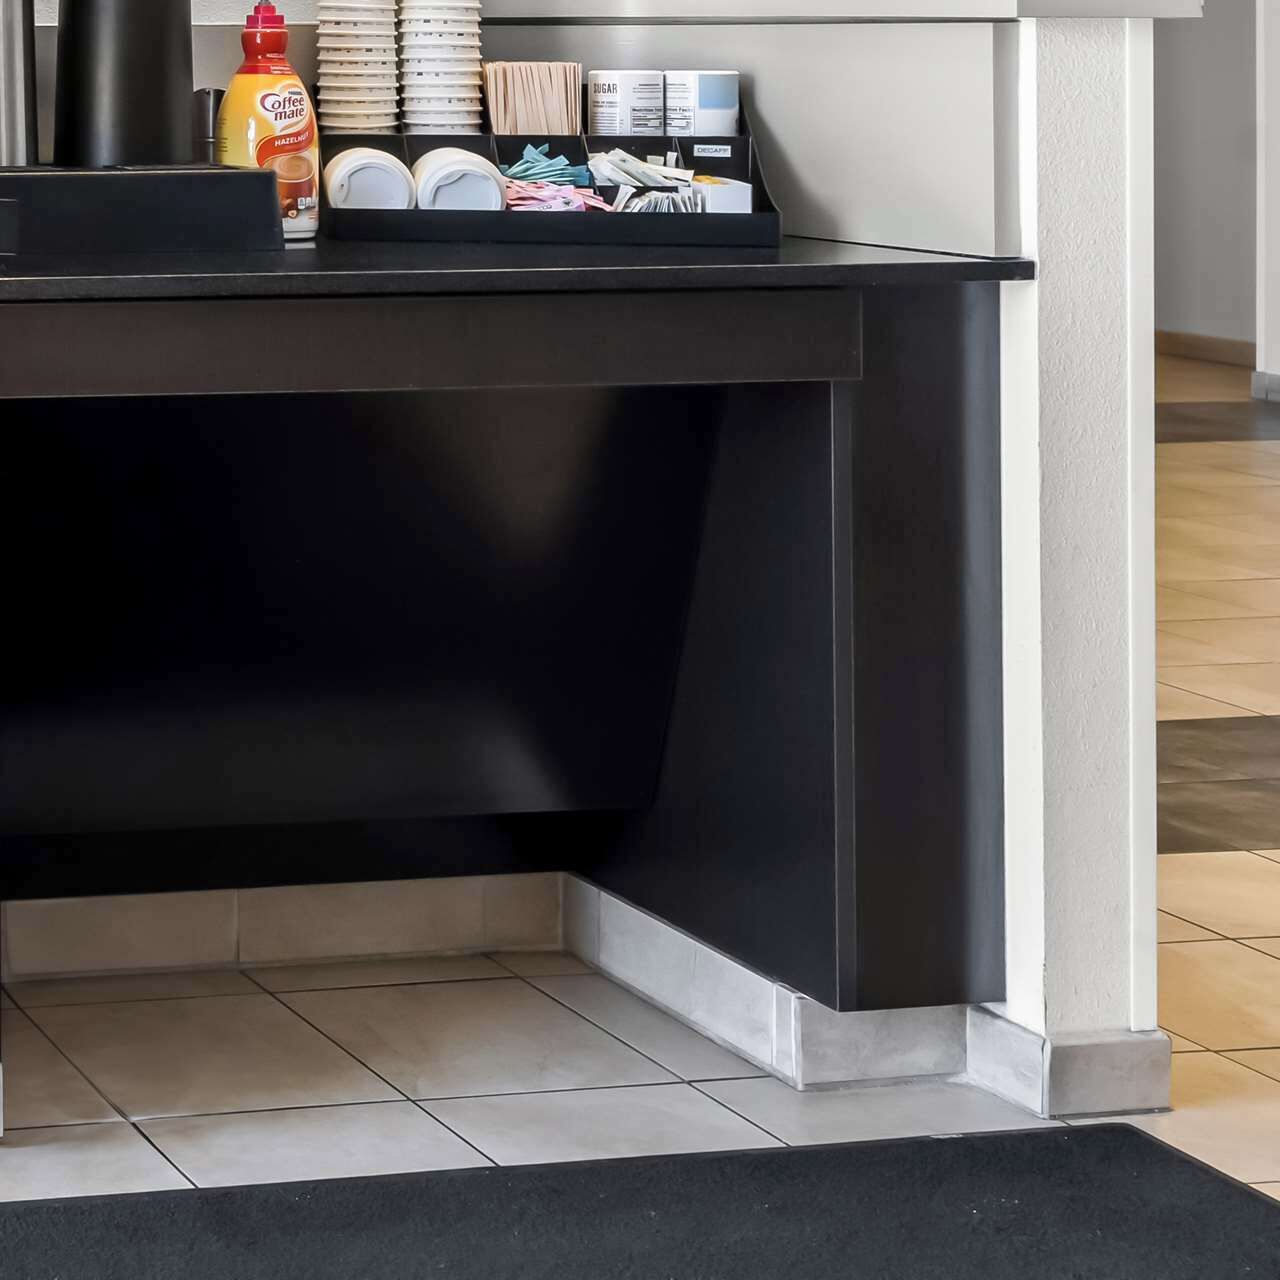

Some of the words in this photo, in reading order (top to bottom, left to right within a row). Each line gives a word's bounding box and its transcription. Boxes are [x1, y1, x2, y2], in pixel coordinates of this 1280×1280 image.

[593, 82, 618, 94] SUGAR
[259, 92, 305, 113] Coffee
[274, 107, 305, 121] mate
[274, 130, 310, 147] HAZELNUT
